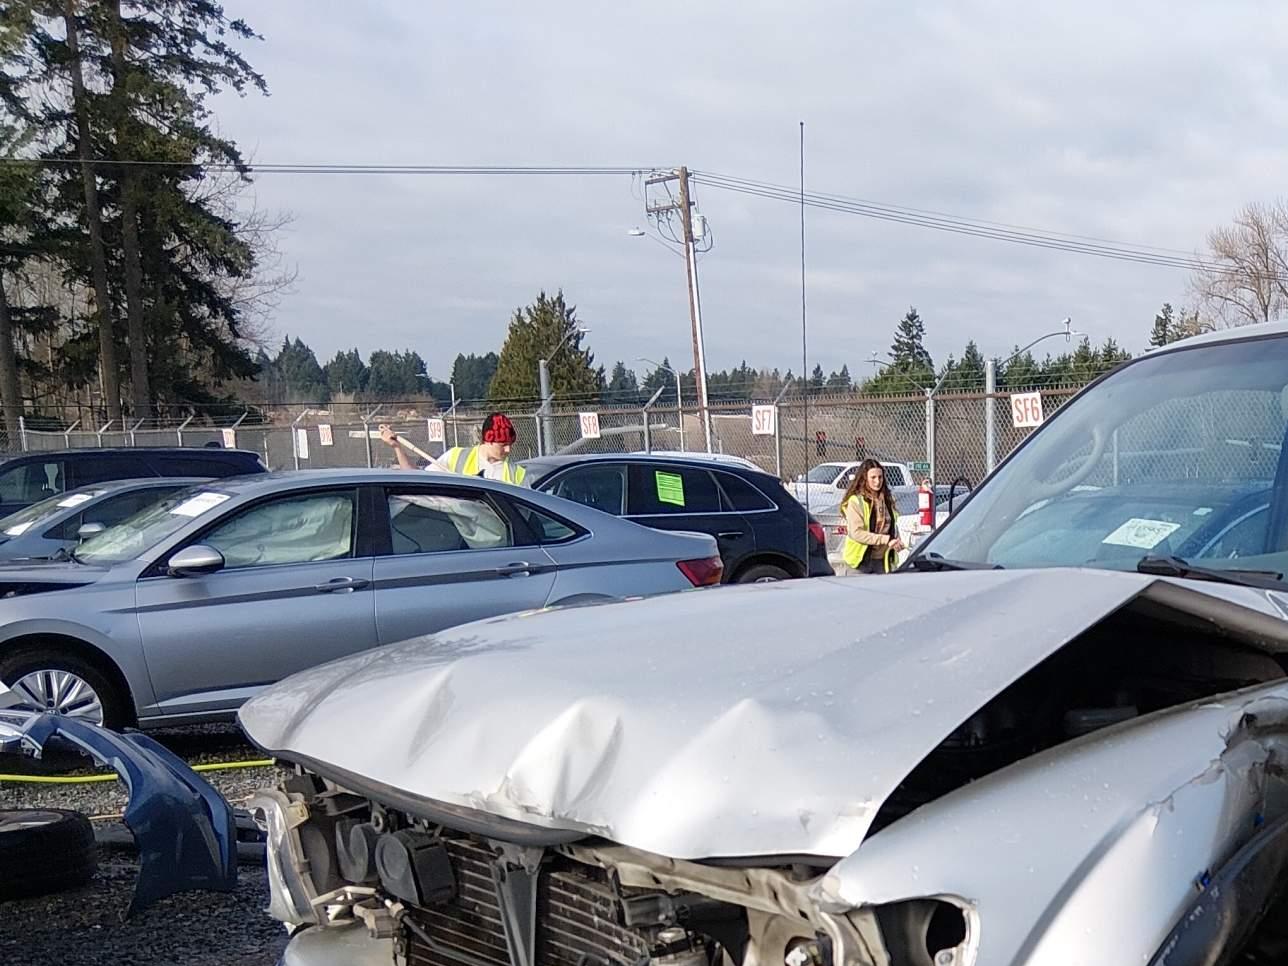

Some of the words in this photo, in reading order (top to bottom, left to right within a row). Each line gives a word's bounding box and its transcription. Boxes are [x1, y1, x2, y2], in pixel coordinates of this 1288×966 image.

[755, 410, 772, 431] SF7
[1014, 397, 1040, 423] SF6
[582, 416, 598, 435] SF8
